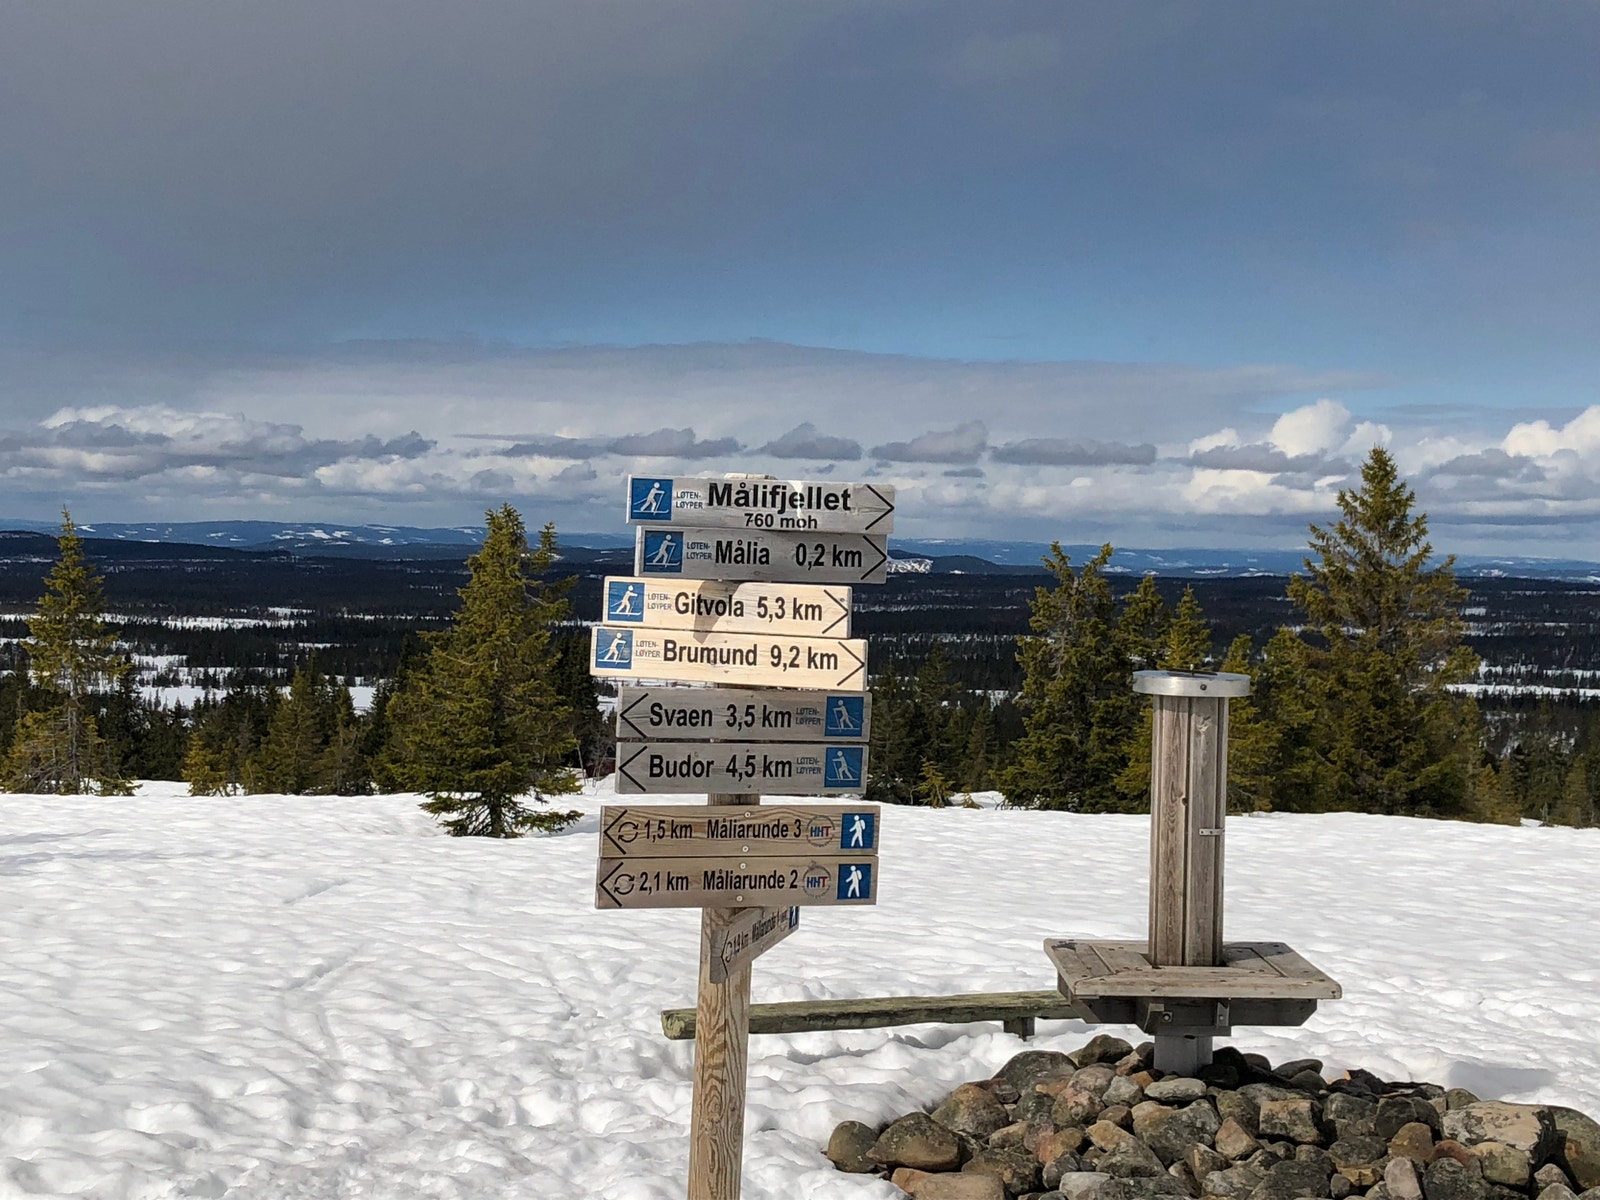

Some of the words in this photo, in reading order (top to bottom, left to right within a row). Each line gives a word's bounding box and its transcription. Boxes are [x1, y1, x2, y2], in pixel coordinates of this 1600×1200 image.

[676, 501, 703, 509] LØYPER
[708, 483, 851, 514] Målifjellet
[744, 513, 774, 527] 760
[780, 515, 818, 529] moh
[686, 552, 712, 560] LØYPER
[715, 539, 770, 565] Målia
[795, 543, 825, 570] 0,2
[833, 544, 862, 567] km
[647, 602, 672, 611] LØYPER
[675, 592, 744, 618] Gitvola
[757, 596, 786, 622] 5,3
[793, 597, 822, 621] km
[635, 649, 660, 658] LØYPER
[663, 639, 757, 666] Brumund
[770, 645, 800, 671] 9,2
[808, 645, 838, 670] km
[650, 702, 713, 727] Svaen
[726, 704, 755, 731] 3,5
[762, 704, 792, 728] km
[649, 754, 714, 779] Budor
[726, 754, 756, 781] 4,5
[763, 755, 792, 778] km
[644, 820, 665, 843] 1,5
[671, 820, 692, 839] km
[707, 818, 788, 839] Måliarunde
[793, 819, 801, 838] 3
[810, 825, 832, 838] HHT
[639, 871, 661, 895] 2,1
[667, 871, 689, 891] km
[703, 870, 786, 891] Måliarunde
[790, 870, 798, 889] 2
[807, 876, 828, 888] HHT
